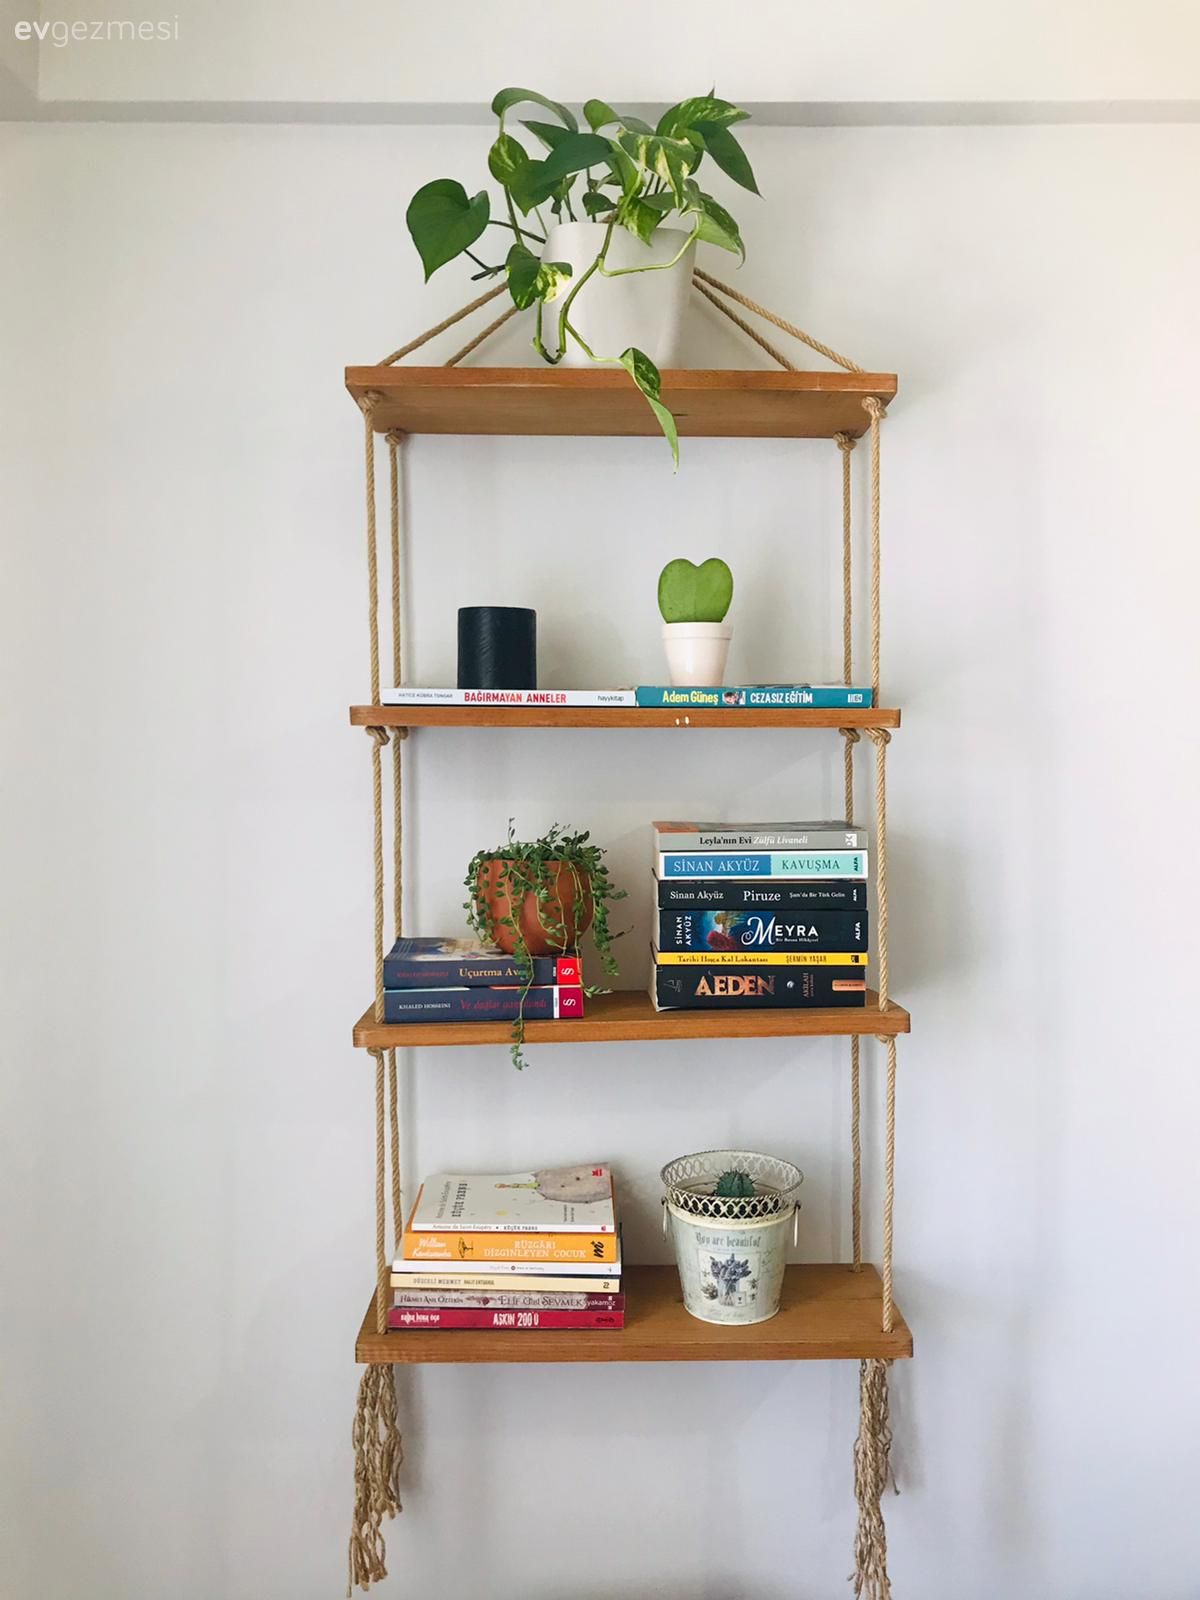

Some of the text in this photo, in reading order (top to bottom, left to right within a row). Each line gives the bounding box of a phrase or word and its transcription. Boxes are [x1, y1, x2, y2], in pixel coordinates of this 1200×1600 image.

[464, 691, 567, 703] BAĞIRMAYAN ANNELER
[662, 690, 719, 705] Adem Güneş
[750, 690, 813, 703] CEZASIZ EĞİTİM
[699, 836, 752, 846] Leyla'nın Evi
[673, 858, 760, 872] SİNAN AKYÜZ
[782, 859, 840, 871] KAVUŞMA
[670, 890, 724, 901] Sinan Akyüz
[743, 890, 781, 901] Piruze
[674, 916, 682, 945] SİNAN
[684, 915, 692, 946] AKYÜZ
[741, 916, 819, 946] MEYRA
[459, 968, 502, 979] Uçurtma
[695, 975, 776, 996] AEDEN
